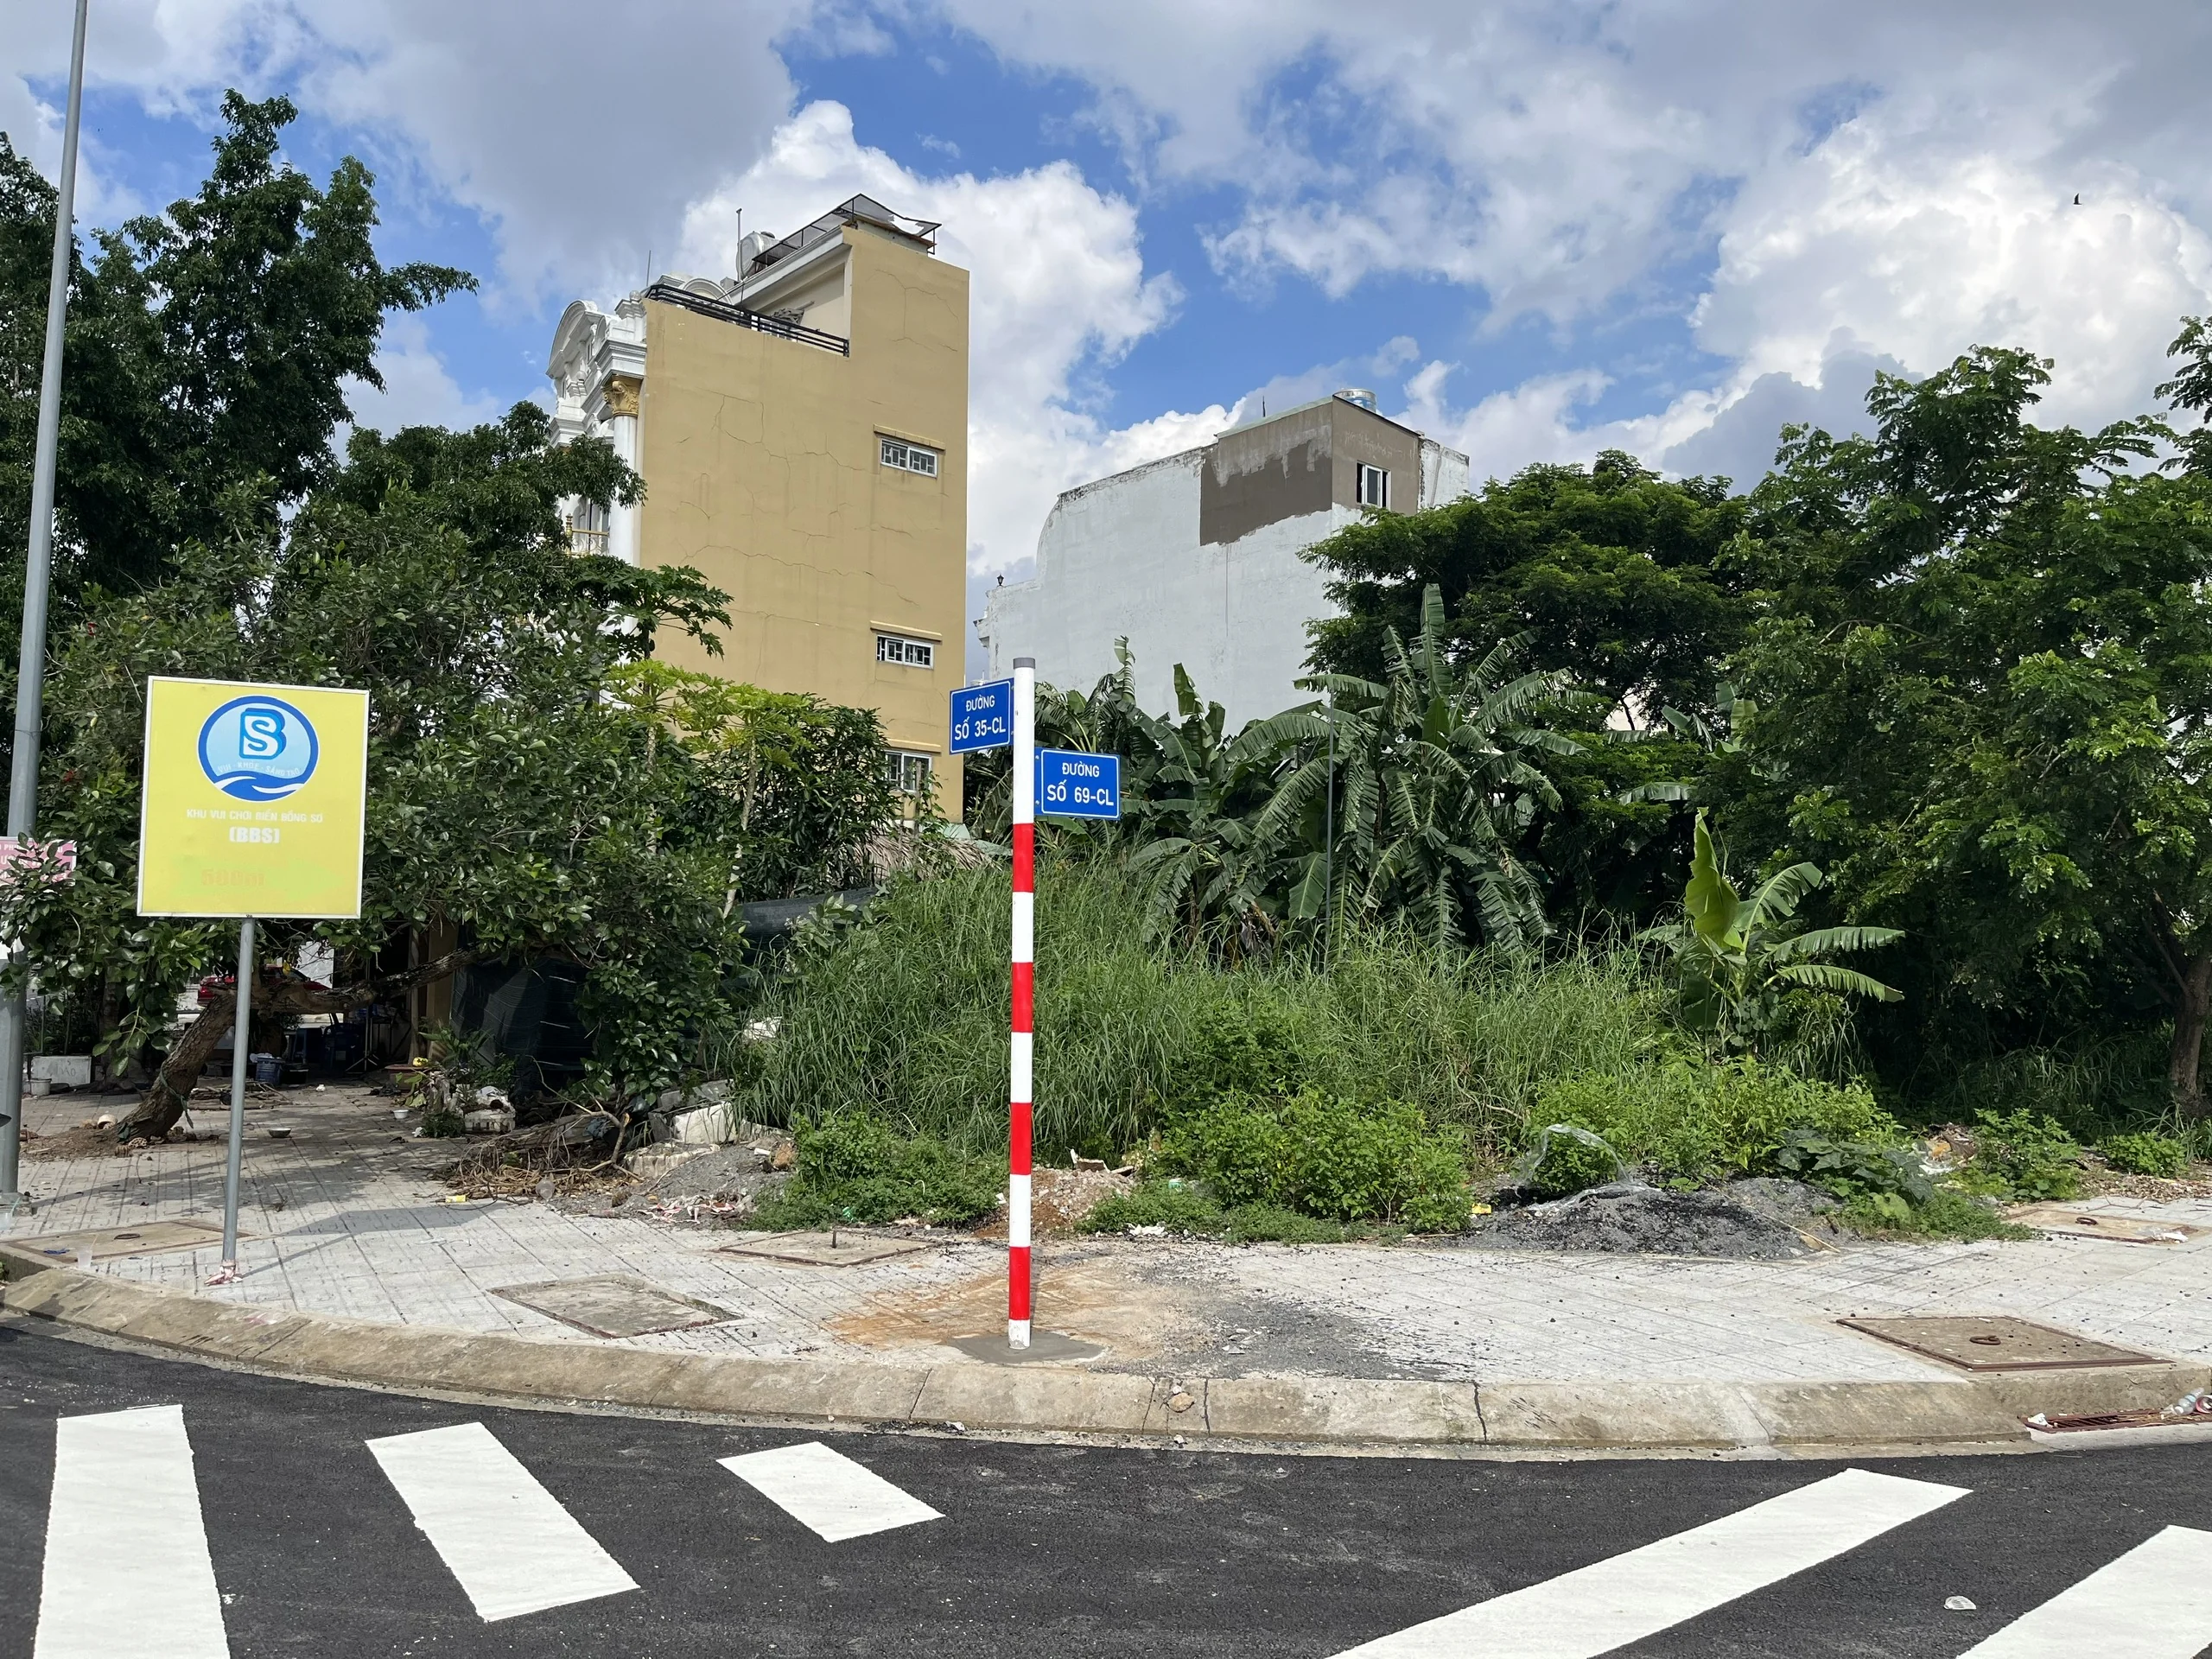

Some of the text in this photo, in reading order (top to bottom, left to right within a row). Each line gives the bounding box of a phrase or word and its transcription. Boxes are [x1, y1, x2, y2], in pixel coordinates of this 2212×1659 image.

[966, 695, 995, 712] ĐƯỜNG
[955, 716, 1006, 741] SỐ 35-CL
[1062, 760, 1100, 778] ĐƯỜNG
[1047, 779, 1115, 806] SỐ 69-CL
[186, 808, 207, 819] KHU
[210, 809, 226, 820] VUI
